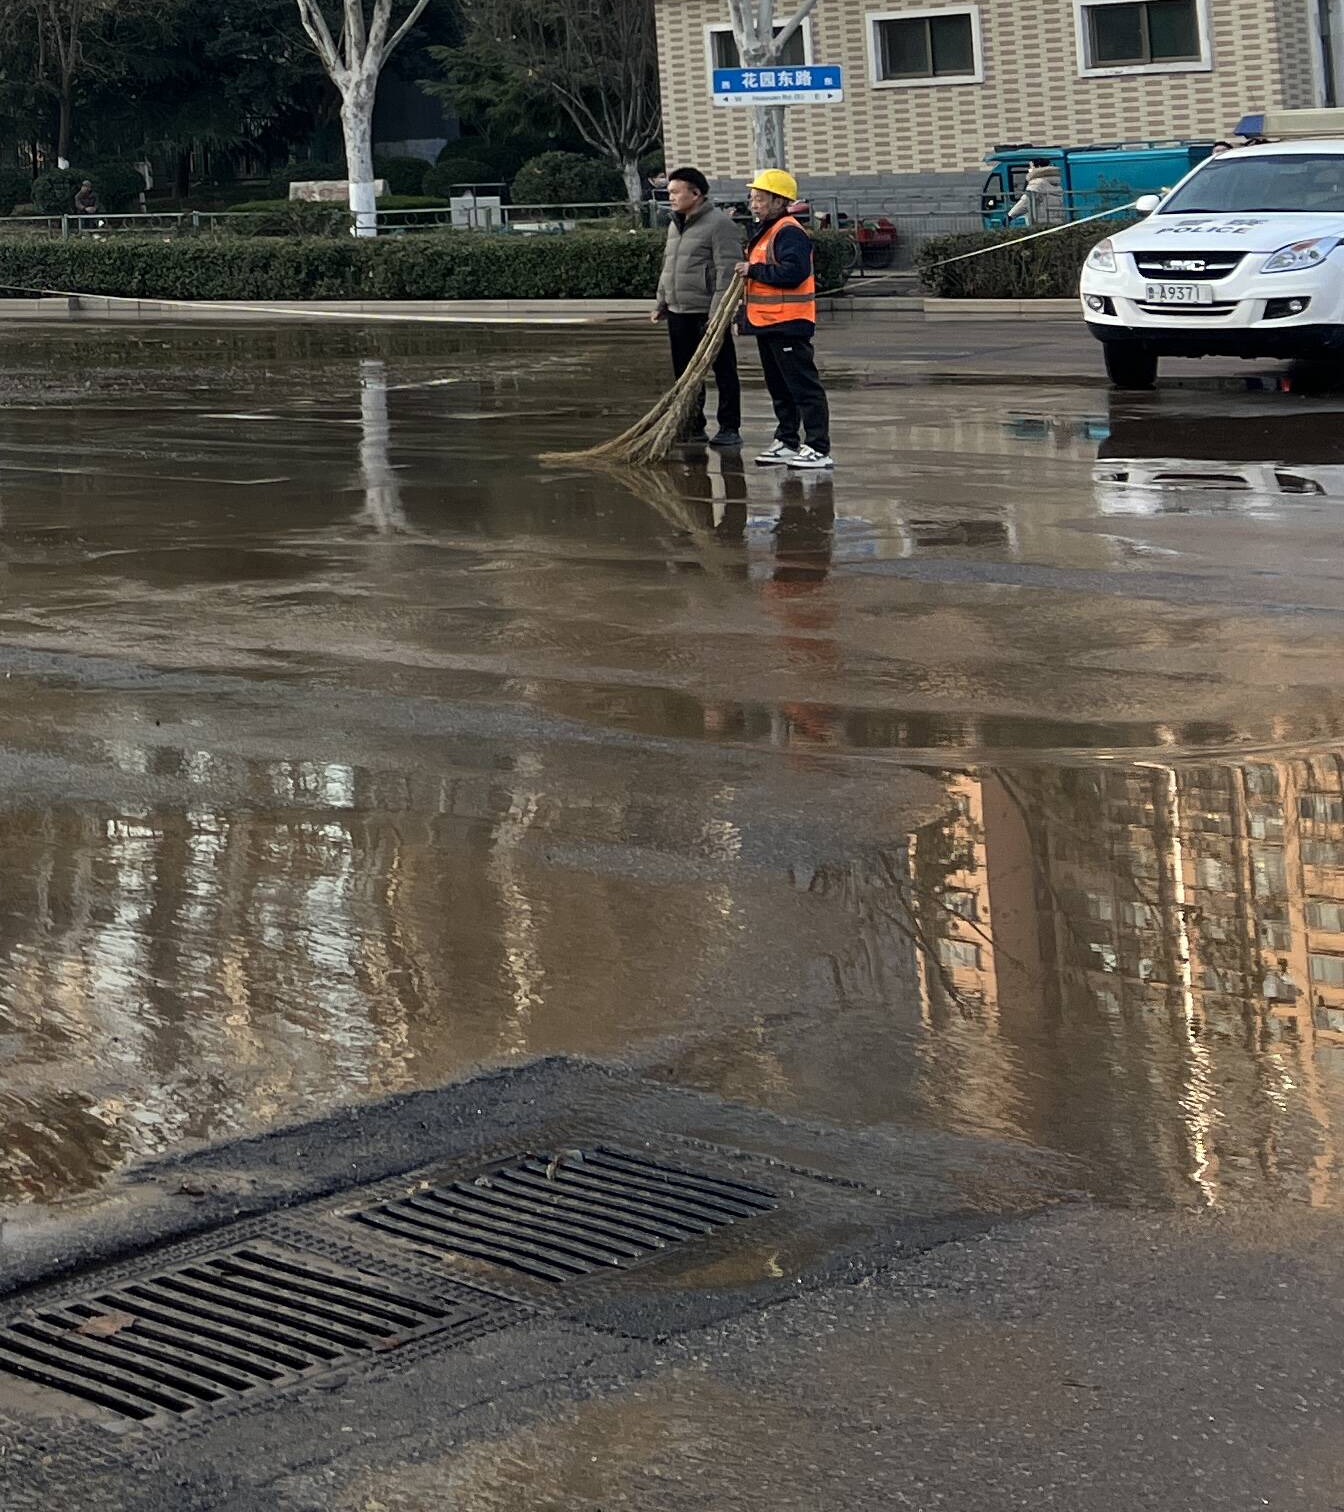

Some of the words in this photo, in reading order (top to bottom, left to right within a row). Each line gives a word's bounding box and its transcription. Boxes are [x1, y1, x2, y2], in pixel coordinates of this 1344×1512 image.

[741, 69, 813, 89] 花园东路
[1155, 226, 1252, 235] POLICE
